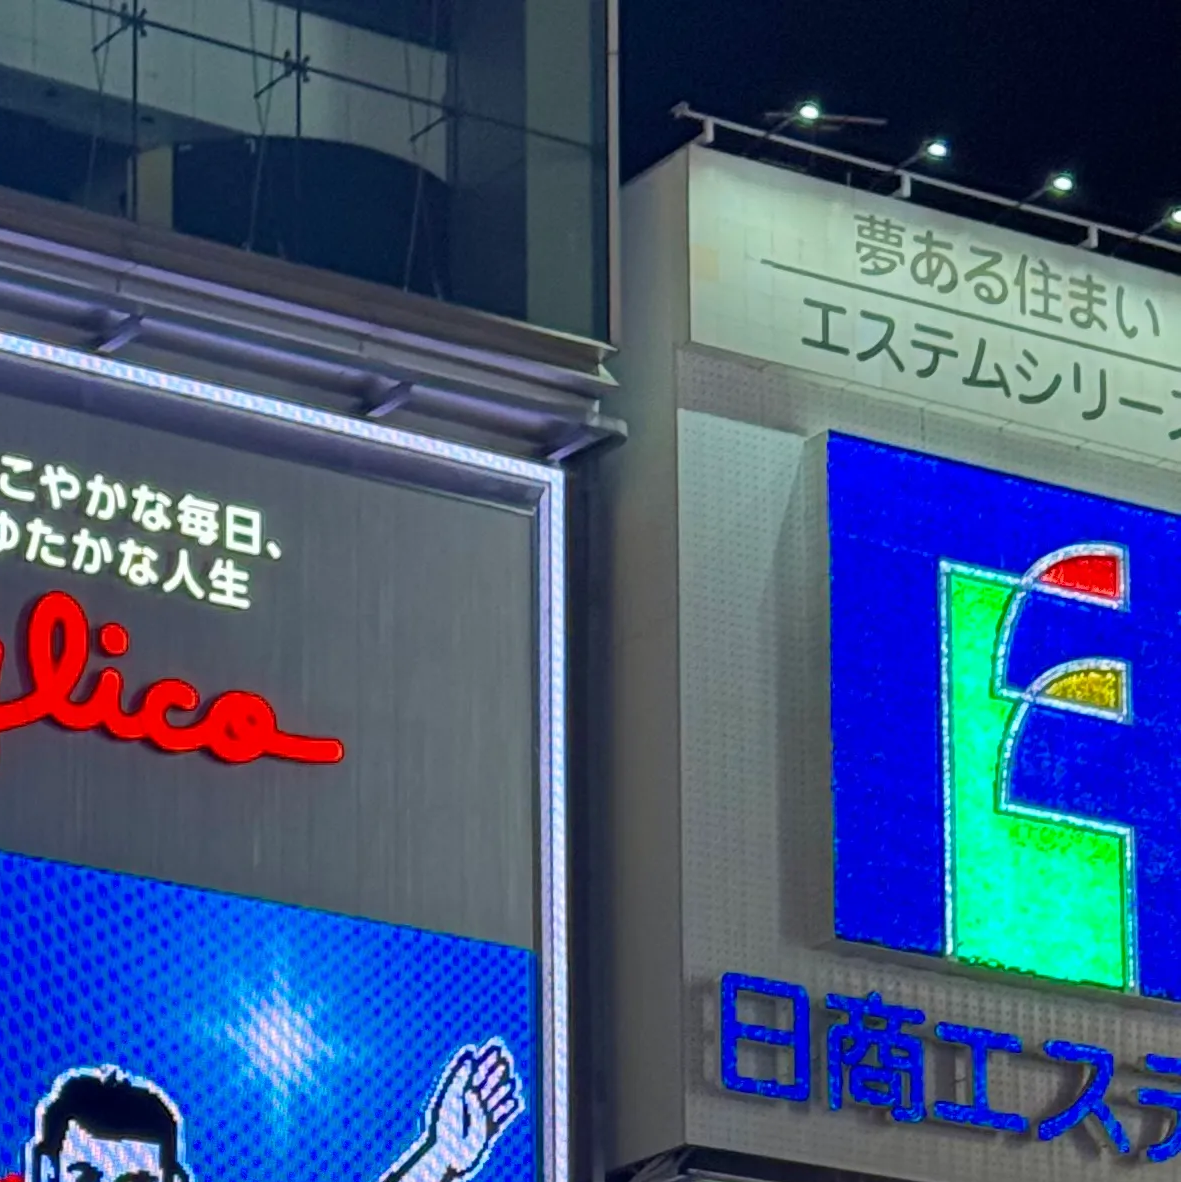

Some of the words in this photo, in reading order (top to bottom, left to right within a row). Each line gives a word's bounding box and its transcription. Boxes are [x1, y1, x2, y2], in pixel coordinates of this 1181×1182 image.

[854, 213, 1161, 340] 夢ある住まい
[801, 296, 1181, 441] エステムシリー
